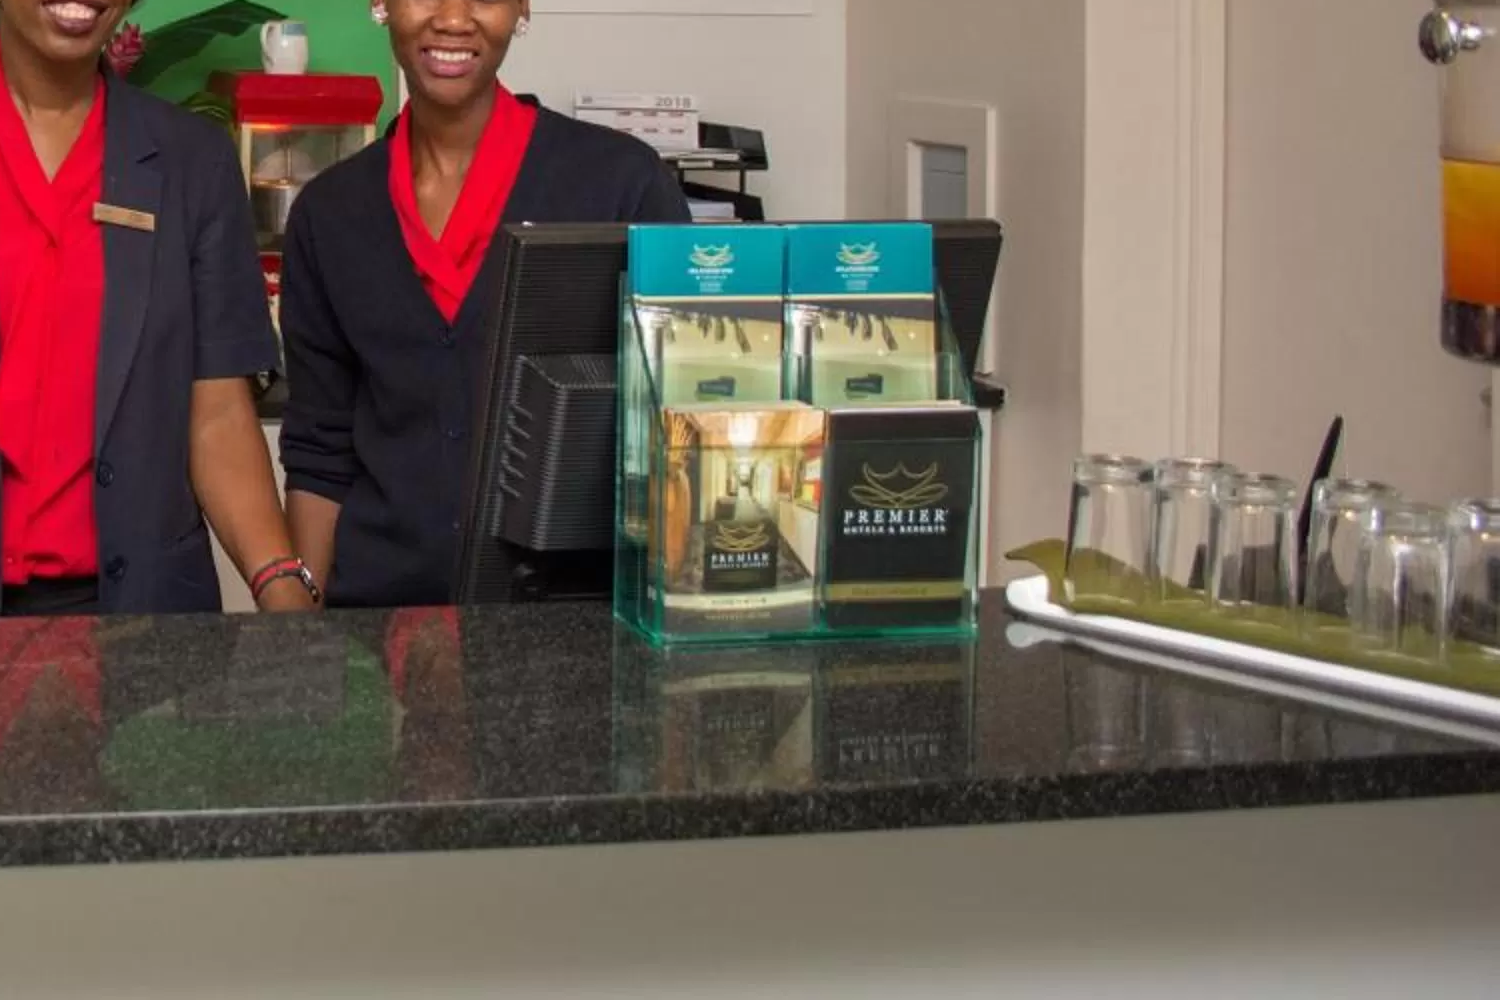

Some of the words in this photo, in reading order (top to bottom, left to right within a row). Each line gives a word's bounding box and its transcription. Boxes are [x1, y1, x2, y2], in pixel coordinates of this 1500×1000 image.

[655, 96, 692, 108] 2018
[843, 508, 947, 524] PREMIER
[711, 552, 769, 564] PREMIER
